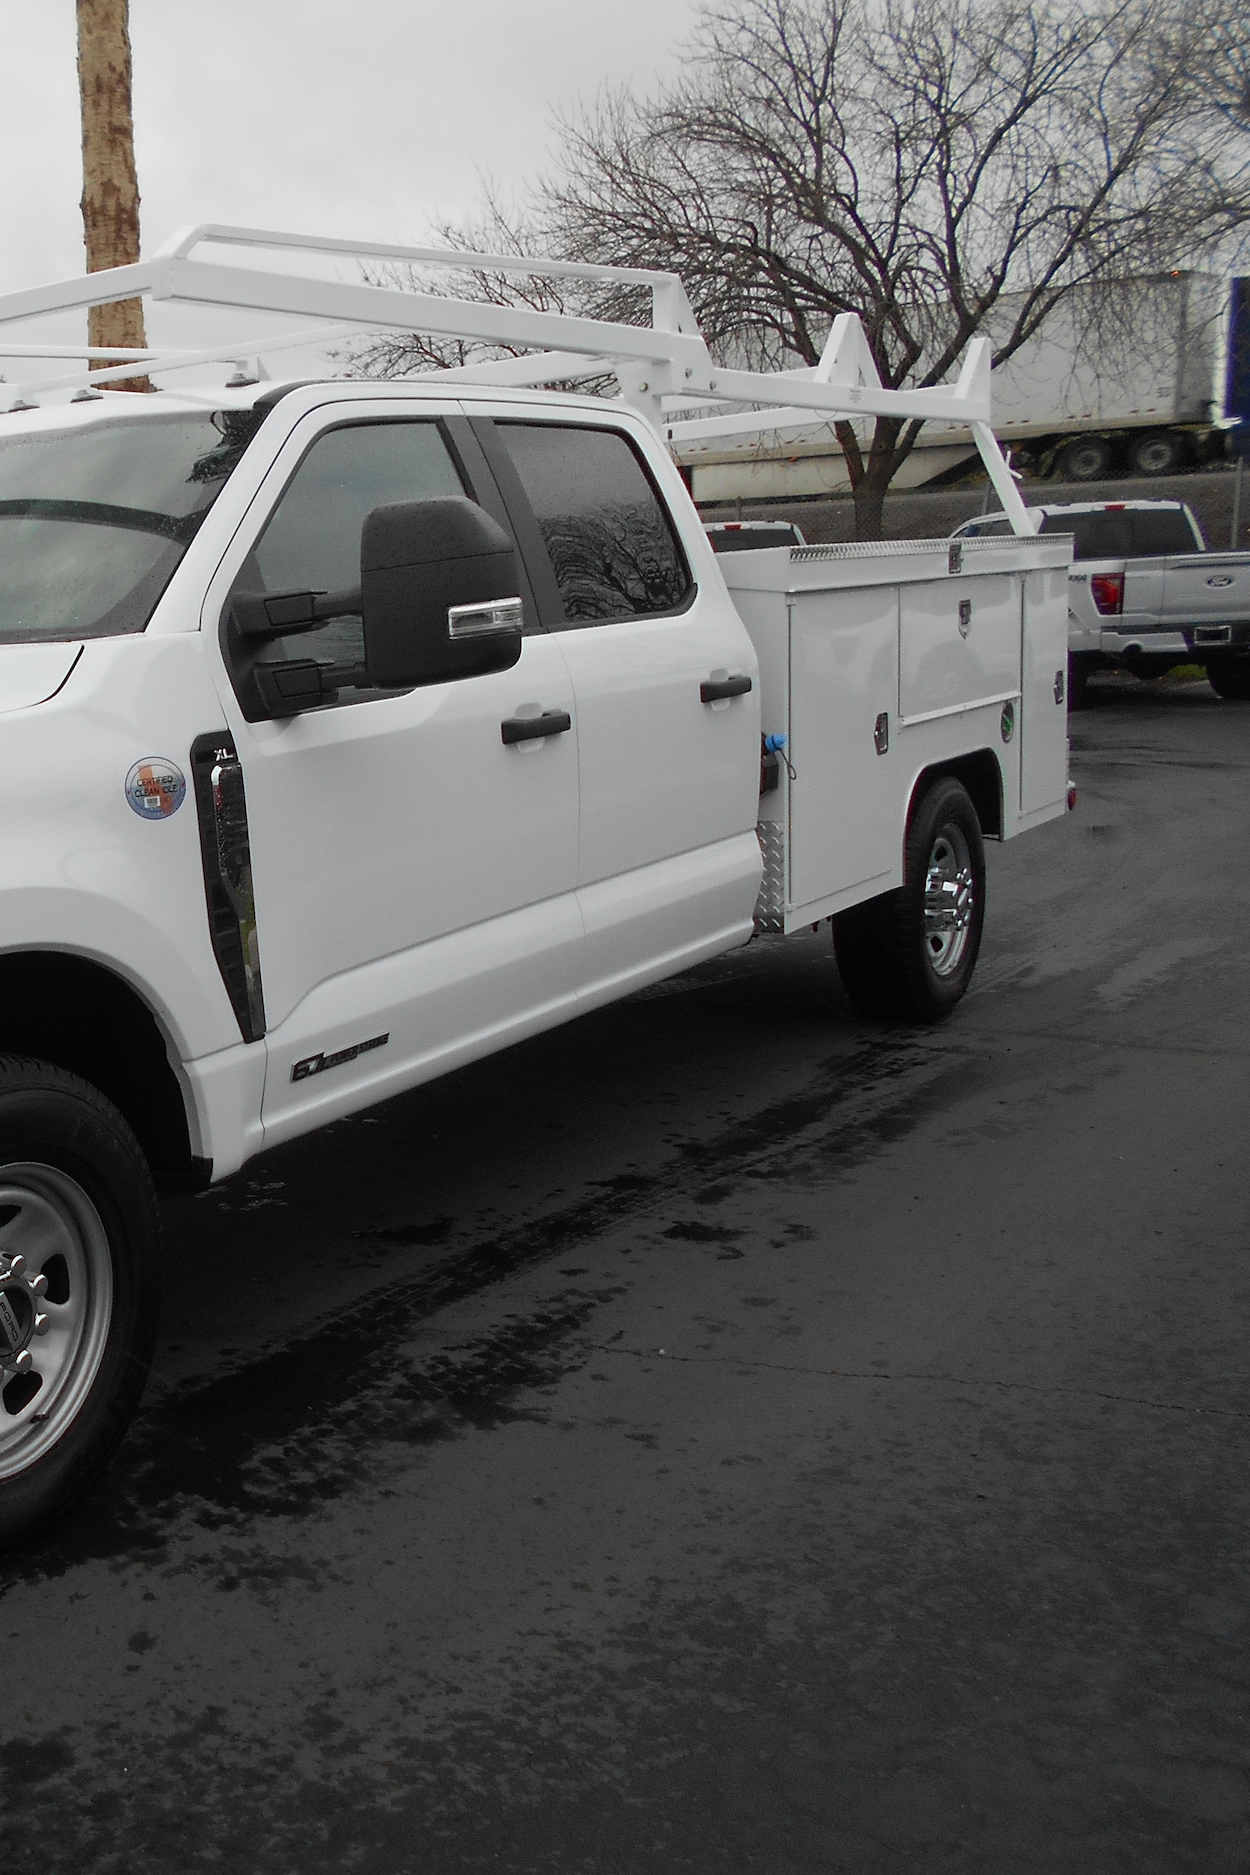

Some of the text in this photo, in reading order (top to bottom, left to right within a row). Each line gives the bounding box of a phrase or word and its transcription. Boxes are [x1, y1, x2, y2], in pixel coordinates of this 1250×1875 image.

[213, 748, 234, 761] XL
[137, 775, 173, 786] CERTIFIED
[134, 785, 179, 797] CLEAN IDLE
[0, 1302, 19, 1341] FORD
